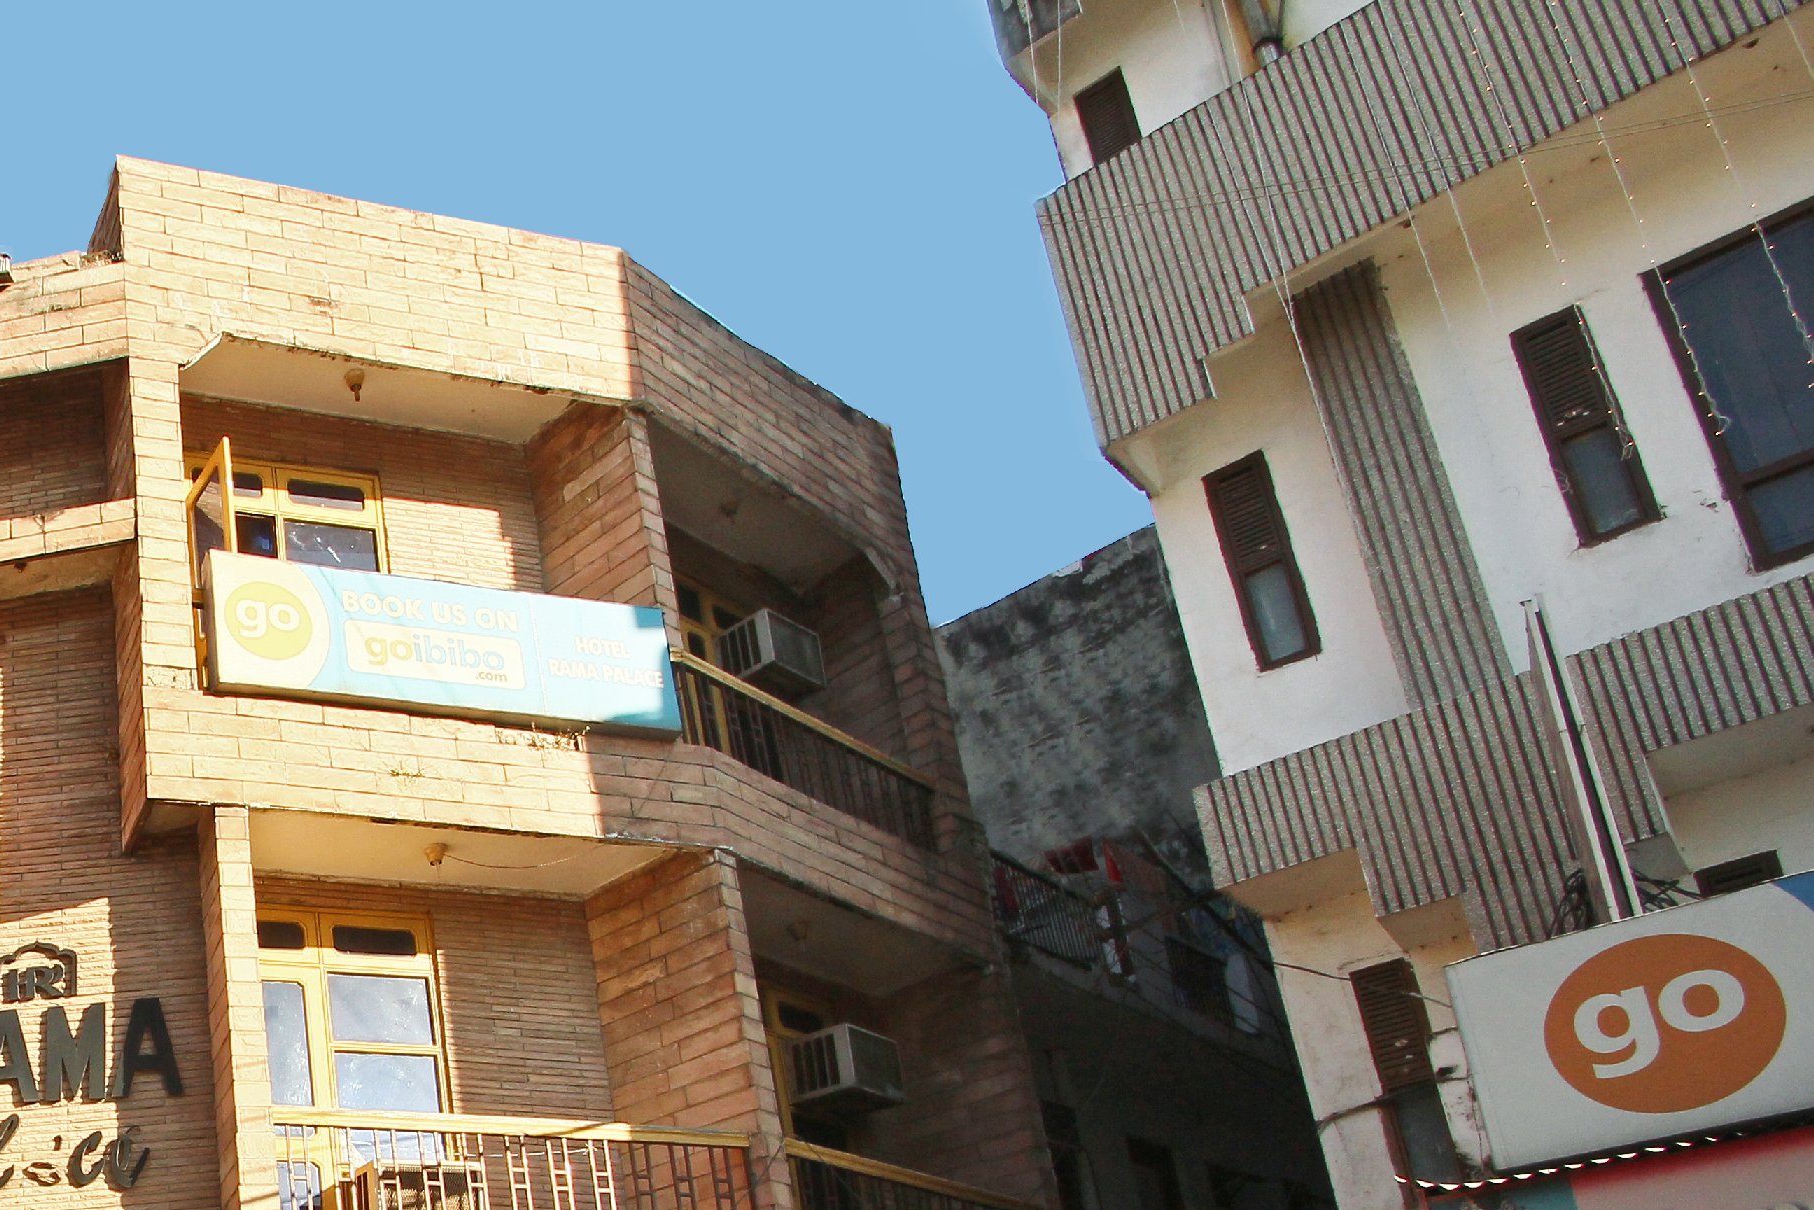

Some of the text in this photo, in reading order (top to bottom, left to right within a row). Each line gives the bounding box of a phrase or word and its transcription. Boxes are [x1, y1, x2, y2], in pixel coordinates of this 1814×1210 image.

[234, 597, 301, 638] go
[341, 590, 520, 632] BOOK US ON
[364, 632, 506, 672] goibibo
[574, 635, 631, 661] HOTEL
[548, 658, 664, 689] RAMA PALACE
[1573, 968, 1746, 1079] go
